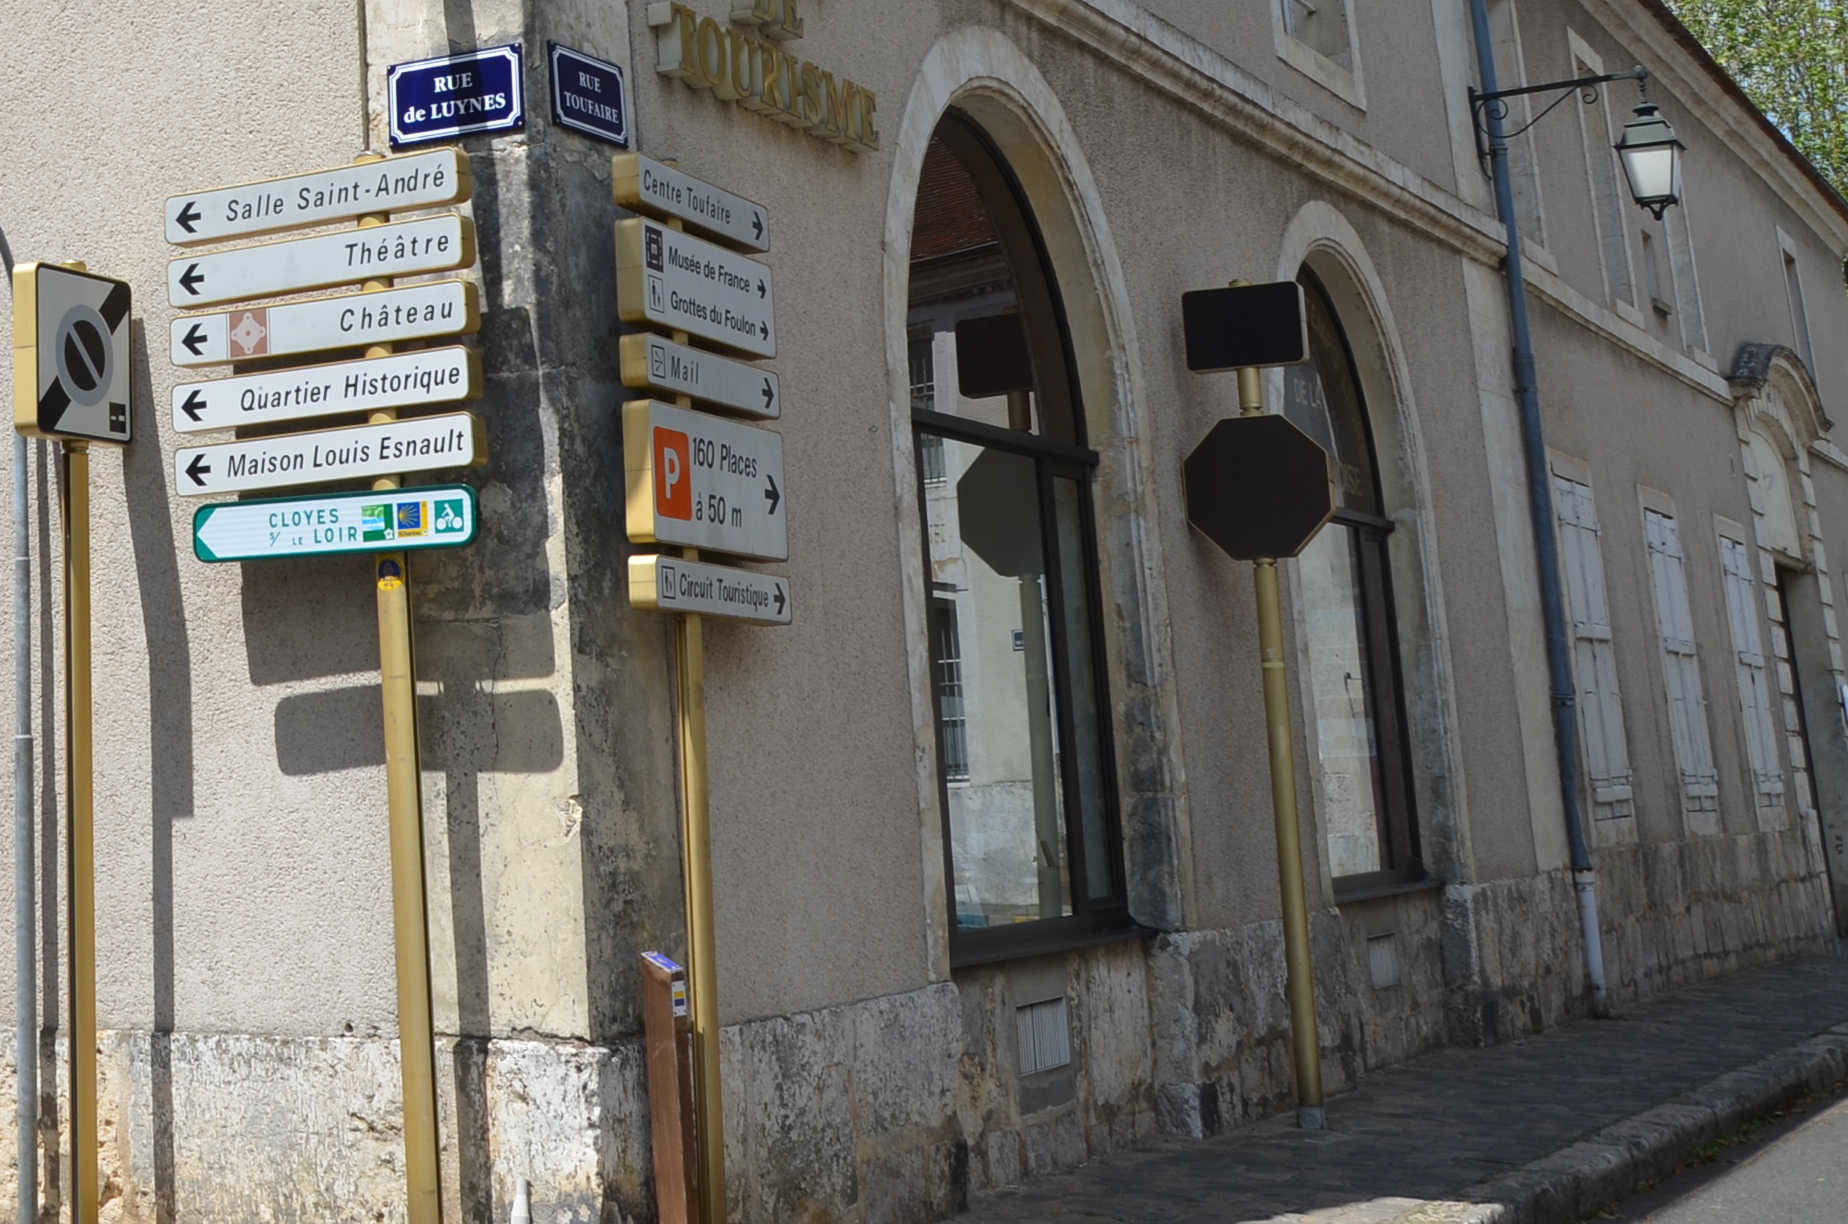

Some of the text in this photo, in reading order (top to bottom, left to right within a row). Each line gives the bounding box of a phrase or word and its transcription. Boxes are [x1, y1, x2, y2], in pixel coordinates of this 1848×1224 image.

[434, 72, 473, 93] RUE
[578, 71, 601, 93] RUE
[660, 1, 879, 152] TOURISME
[404, 93, 506, 124] de LUYNES
[563, 90, 620, 124] TOUFAIRE
[225, 165, 445, 222] Salle Saint-André
[643, 169, 731, 225] Centre Toufaire
[344, 235, 449, 267] Théâtre
[668, 245, 750, 293] Musée de France
[340, 301, 453, 332] Château
[670, 290, 756, 337] Grottes du Foulon
[670, 354, 699, 384] Mail
[240, 365, 460, 412] Quartier Historique
[227, 429, 464, 478] Maison Louis Esnault
[663, 446, 681, 499] P
[692, 436, 757, 478] 160 Places
[269, 508, 339, 528] CLOYES
[695, 492, 742, 528] à 50 m
[292, 536, 303, 545] LE
[314, 526, 358, 544] LOIR
[679, 572, 769, 612] Circuit Touristique
